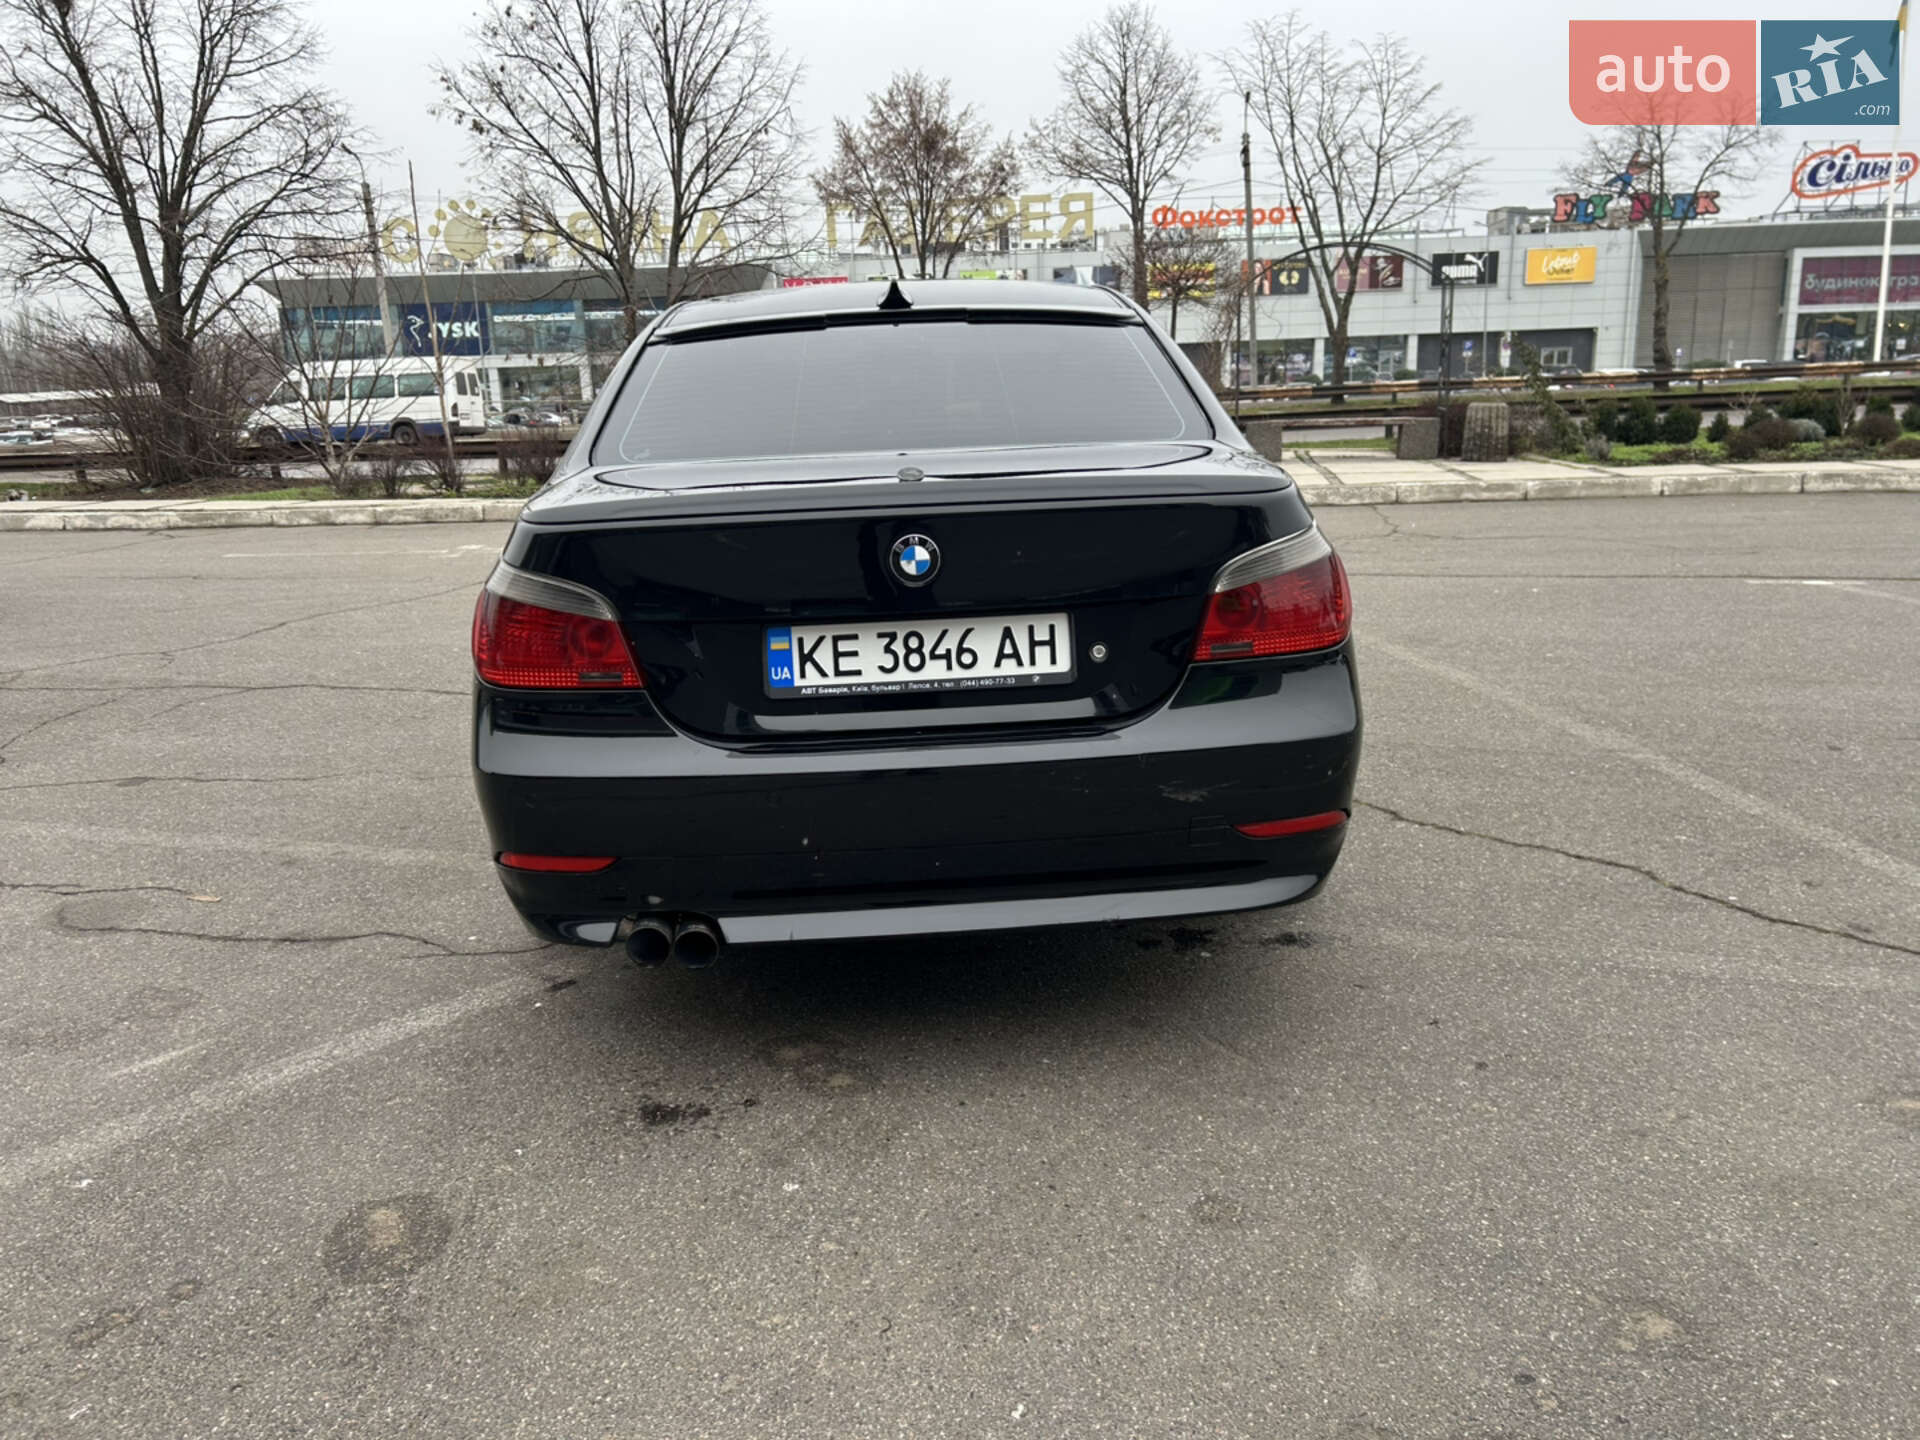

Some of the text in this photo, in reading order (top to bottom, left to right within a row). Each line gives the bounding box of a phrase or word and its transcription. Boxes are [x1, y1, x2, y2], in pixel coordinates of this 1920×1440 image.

[1152, 205, 1302, 229] Фокстрот
[1552, 191, 1720, 224] FLY PARK
[1805, 273, 1880, 291] будинок
[797, 624, 1057, 679] KE 3846 AH
[771, 668, 791, 681] UA
[960, 679, 979, 689] (044)
